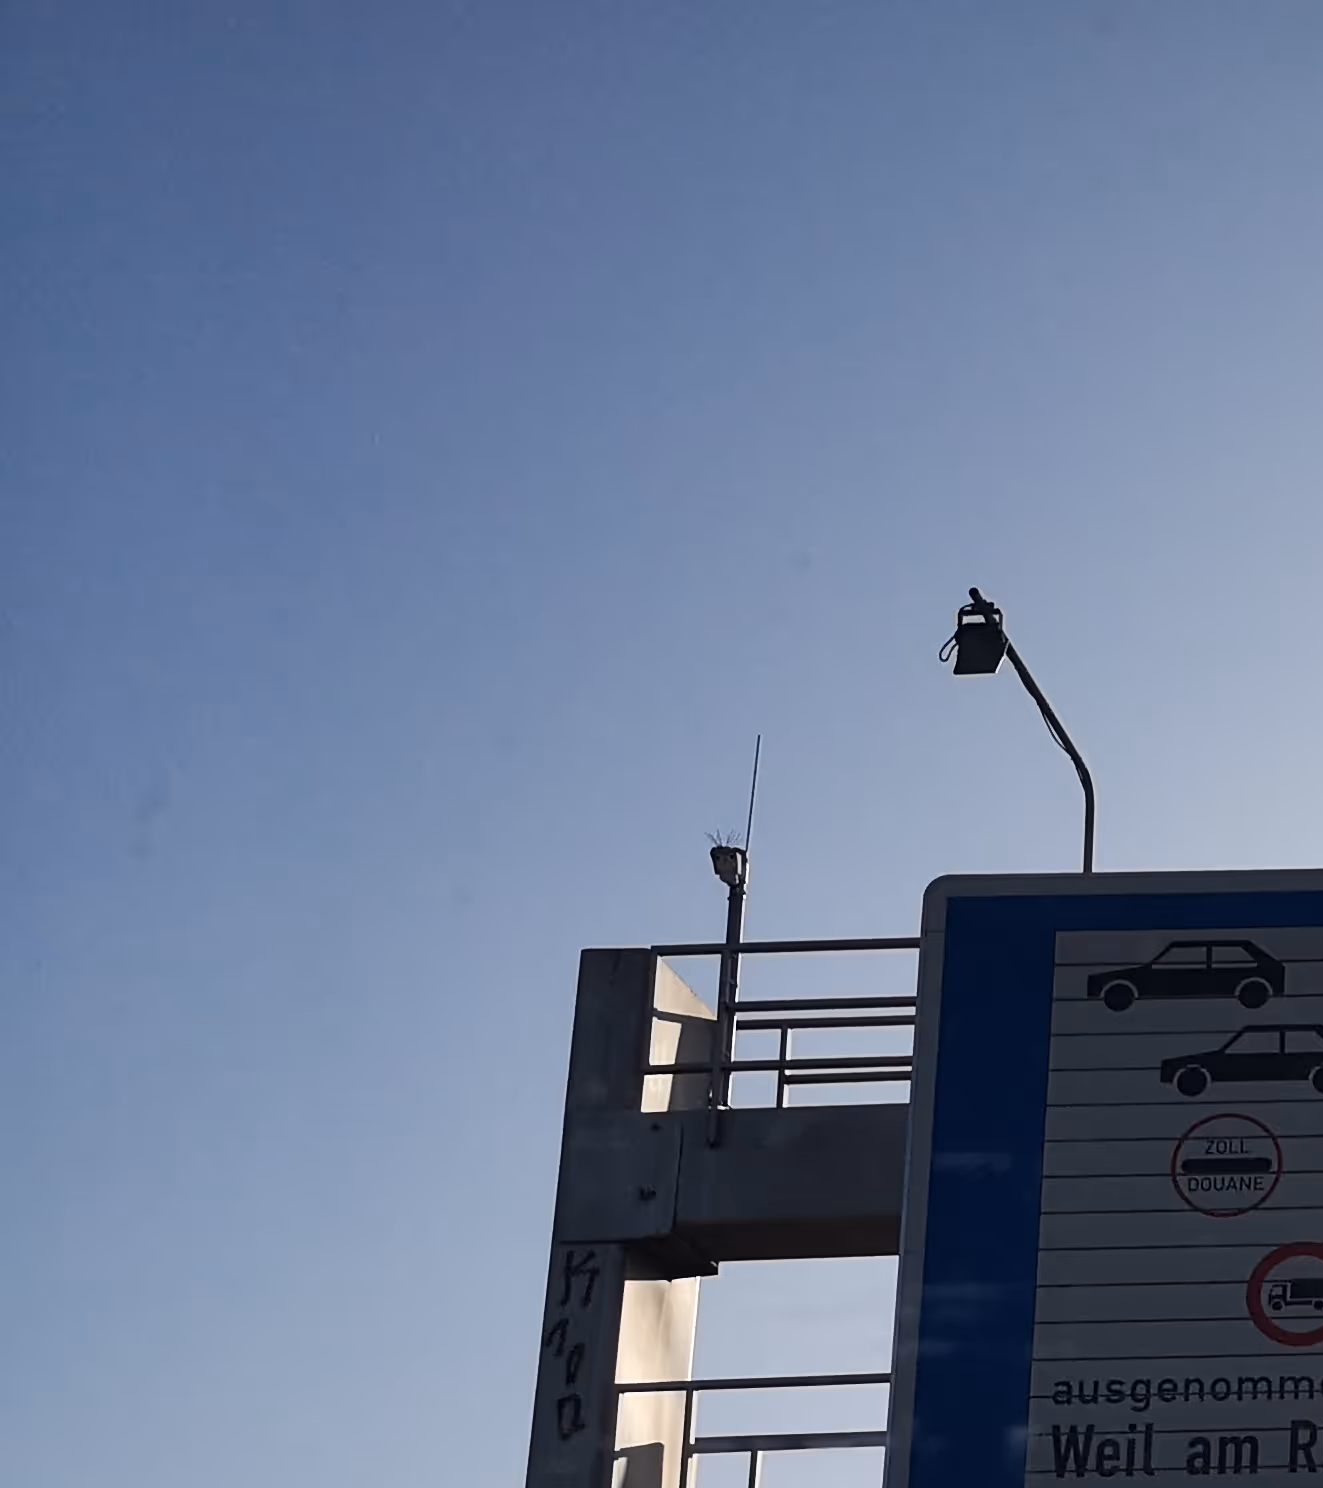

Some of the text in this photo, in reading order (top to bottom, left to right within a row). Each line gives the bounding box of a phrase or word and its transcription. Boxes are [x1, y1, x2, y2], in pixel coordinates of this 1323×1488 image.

[1204, 1137, 1250, 1156] ZOLL
[1186, 1174, 1265, 1194] DOUANE
[1051, 1422, 1155, 1479] Weil
[1185, 1434, 1260, 1475] am
